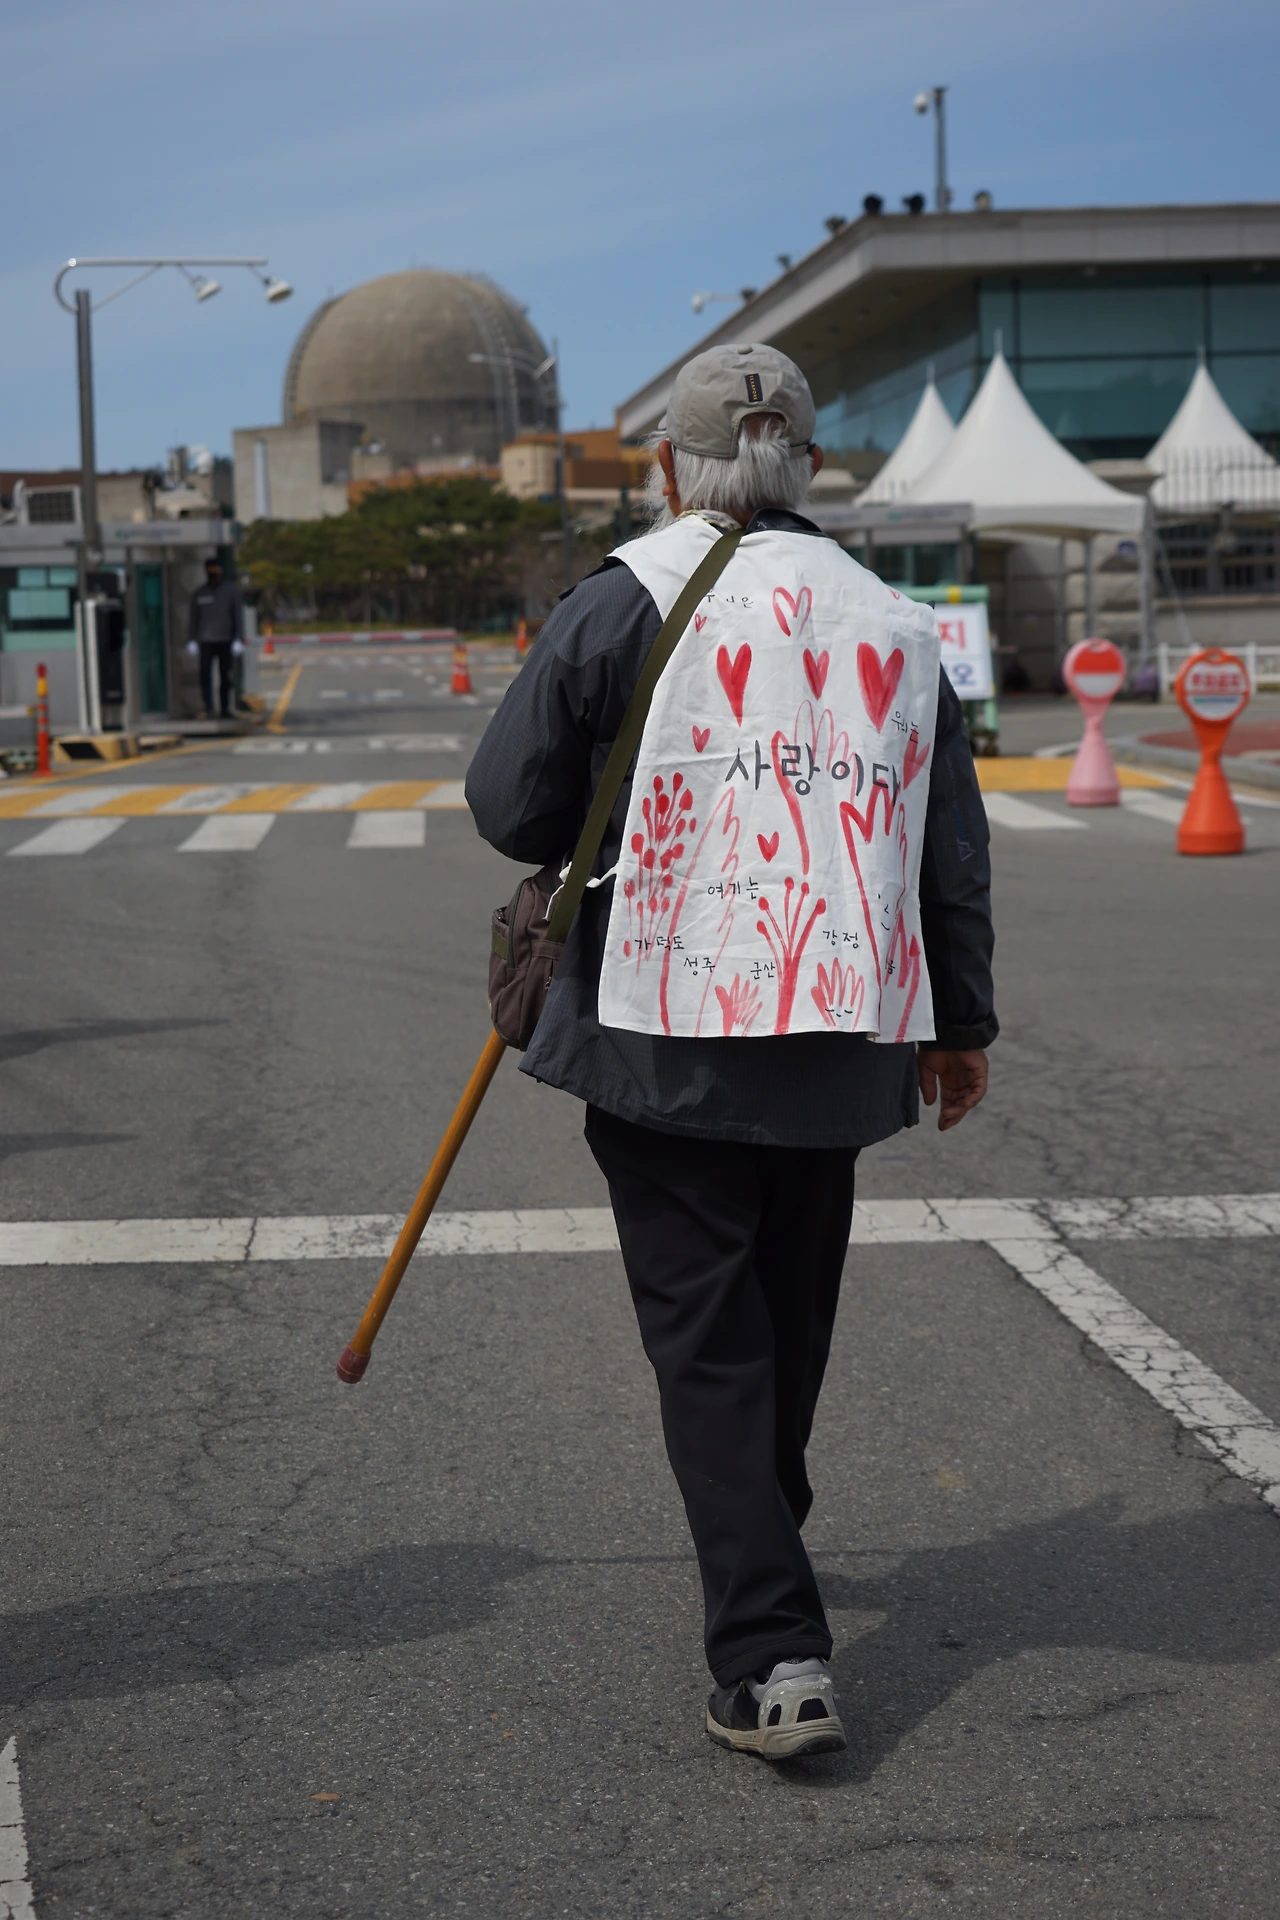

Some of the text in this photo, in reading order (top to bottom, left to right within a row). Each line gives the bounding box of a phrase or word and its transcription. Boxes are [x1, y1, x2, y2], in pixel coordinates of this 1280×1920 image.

[938, 618, 966, 650] 지
[725, 740, 899, 807] 사랑이다
[707, 876, 759, 900] 여기는
[634, 935, 684, 951] 가덕도
[823, 929, 859, 949] 강정
[683, 957, 716, 976] 성주
[750, 961, 776, 980] 군산
